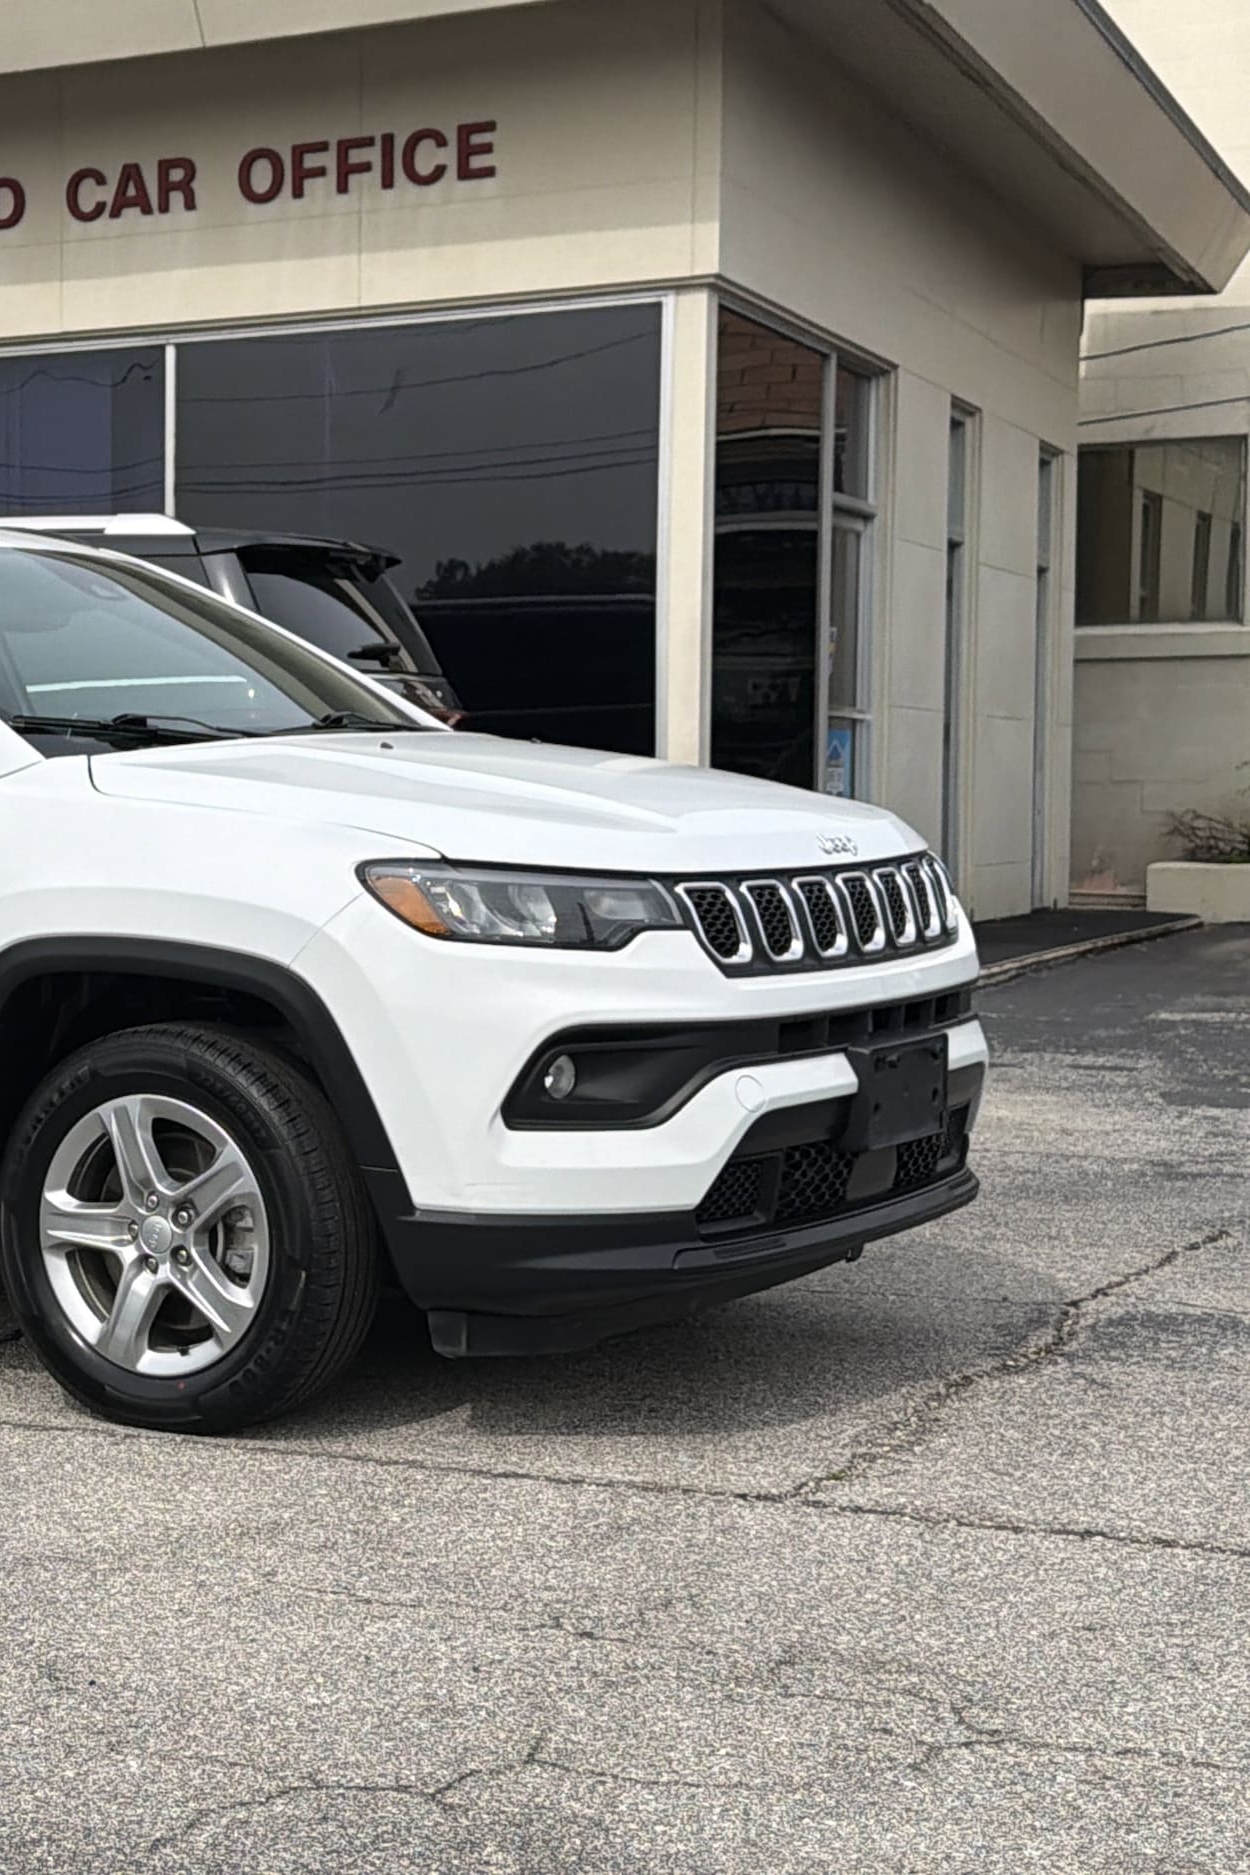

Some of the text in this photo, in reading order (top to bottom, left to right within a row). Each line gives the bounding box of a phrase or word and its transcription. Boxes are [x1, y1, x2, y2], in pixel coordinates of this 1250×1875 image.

[65, 157, 198, 221] CAR
[237, 120, 497, 205] OFFICE
[816, 832, 859, 857] Jeep
